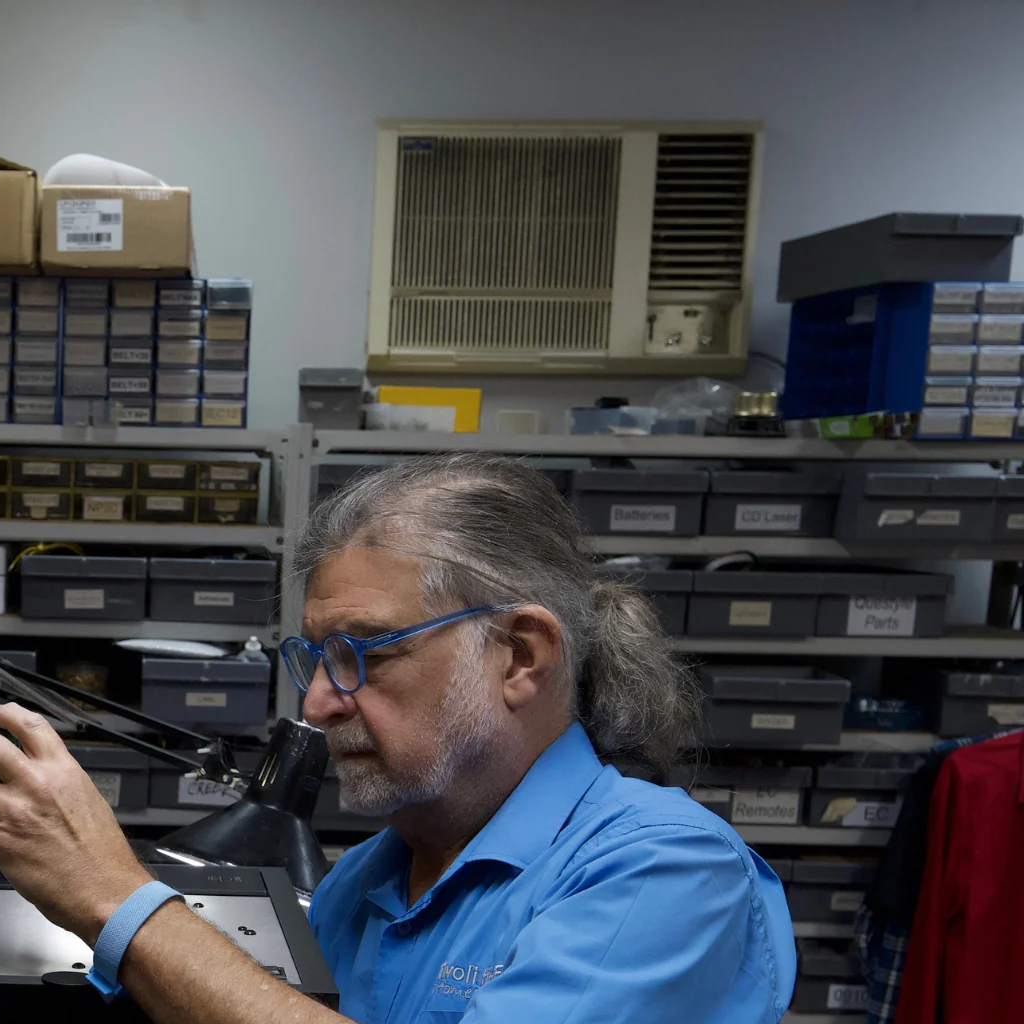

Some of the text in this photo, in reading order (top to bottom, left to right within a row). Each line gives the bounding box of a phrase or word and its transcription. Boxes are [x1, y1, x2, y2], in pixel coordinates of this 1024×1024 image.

[614, 508, 671, 522] Batteries
[764, 510, 799, 523] Laser
[864, 616, 900, 630] Parts
[734, 803, 796, 818] Remotes
[863, 806, 890, 821] EC
